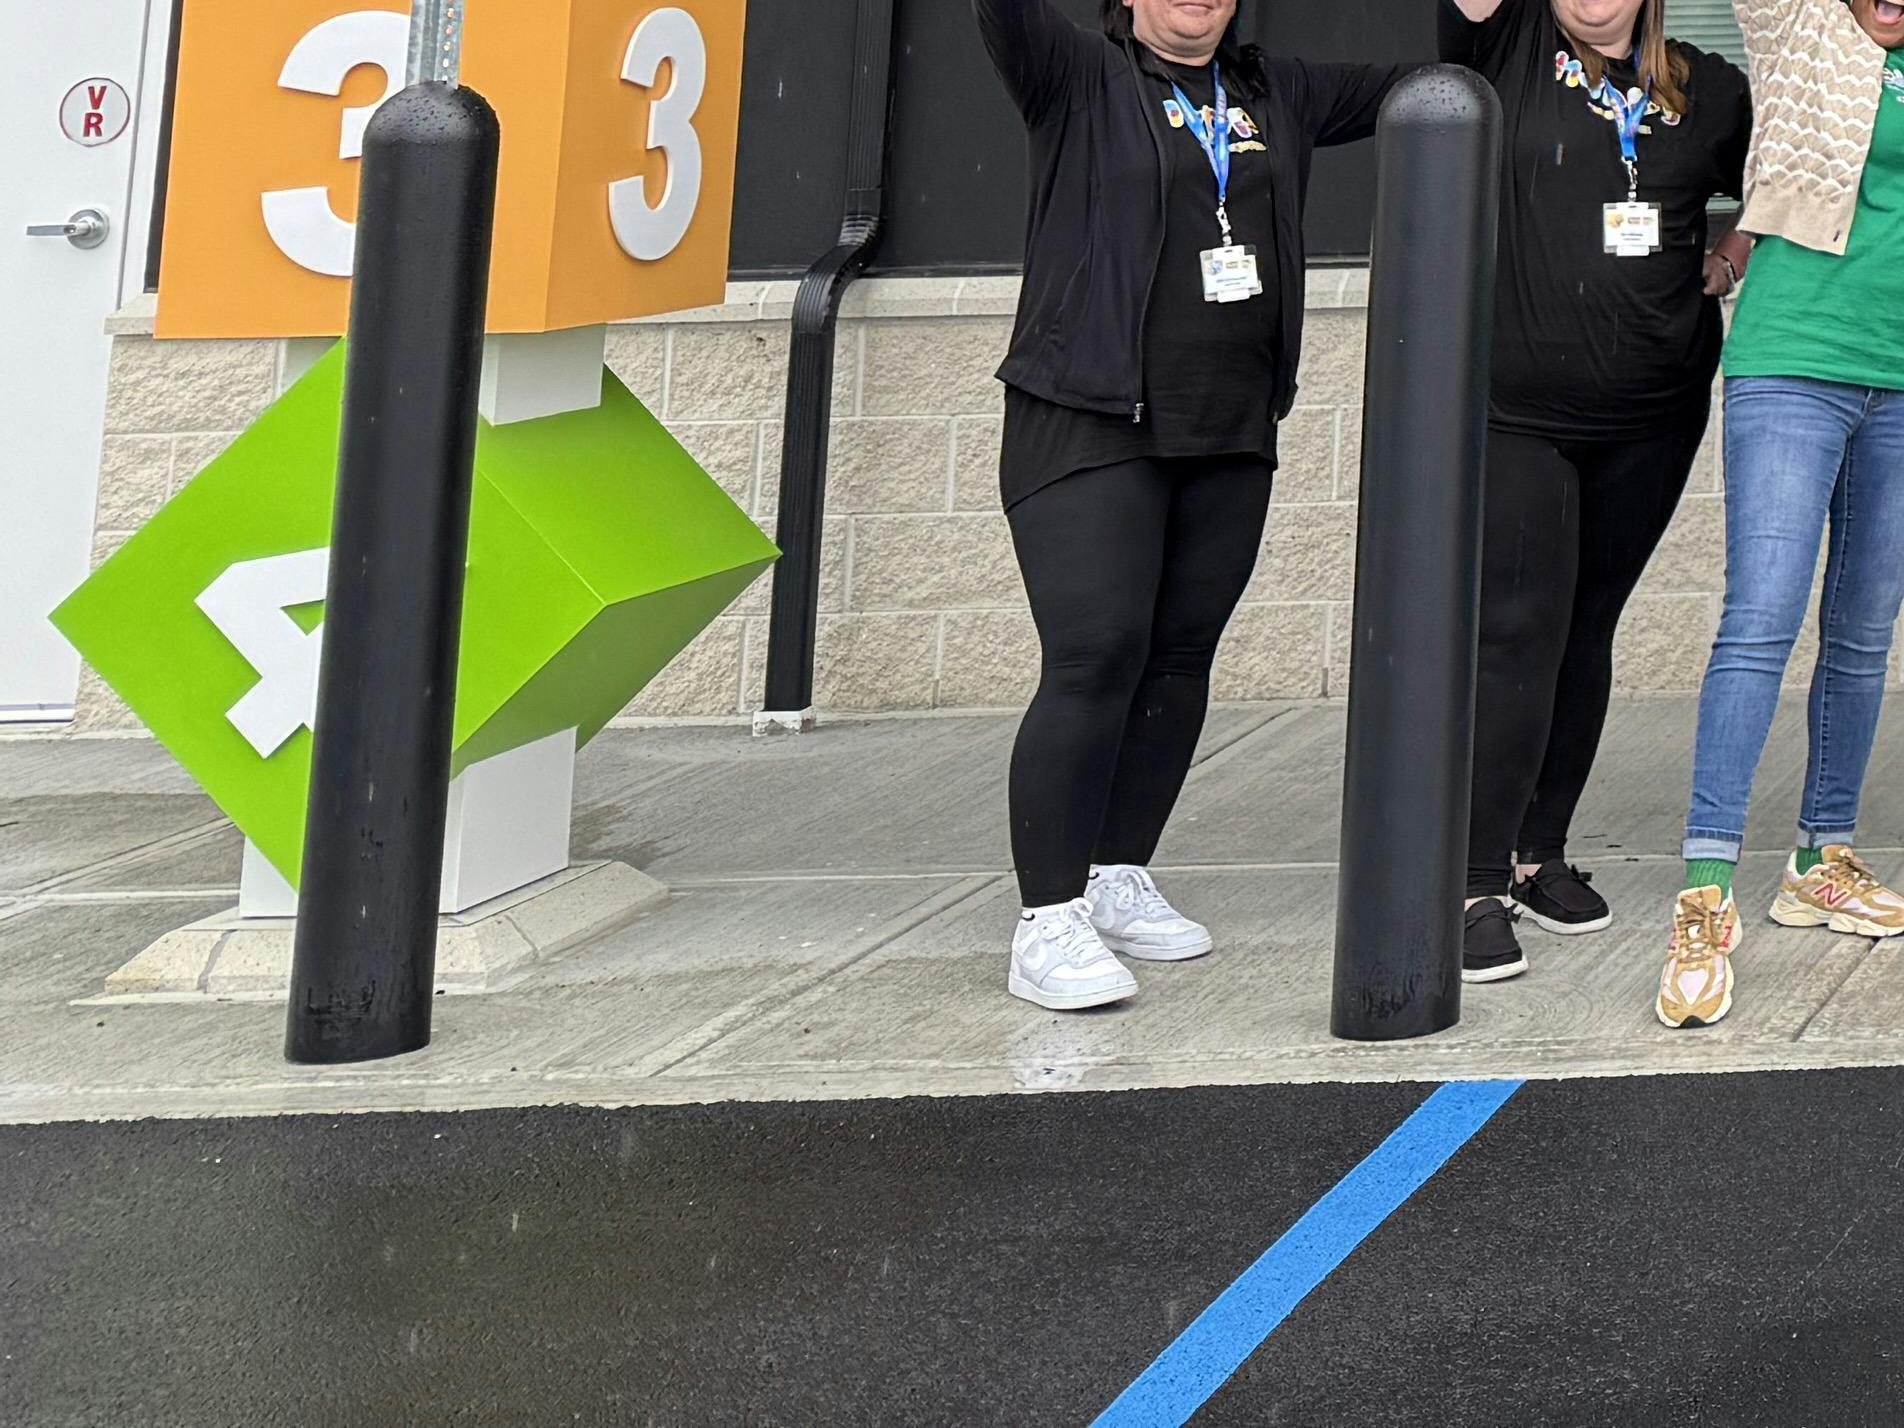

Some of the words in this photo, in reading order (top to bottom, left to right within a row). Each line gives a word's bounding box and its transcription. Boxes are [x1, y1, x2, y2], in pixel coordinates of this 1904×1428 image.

[82, 111, 104, 138] R
[87, 85, 108, 110] V
[258, 9, 412, 277] 3
[607, 6, 707, 263] 3
